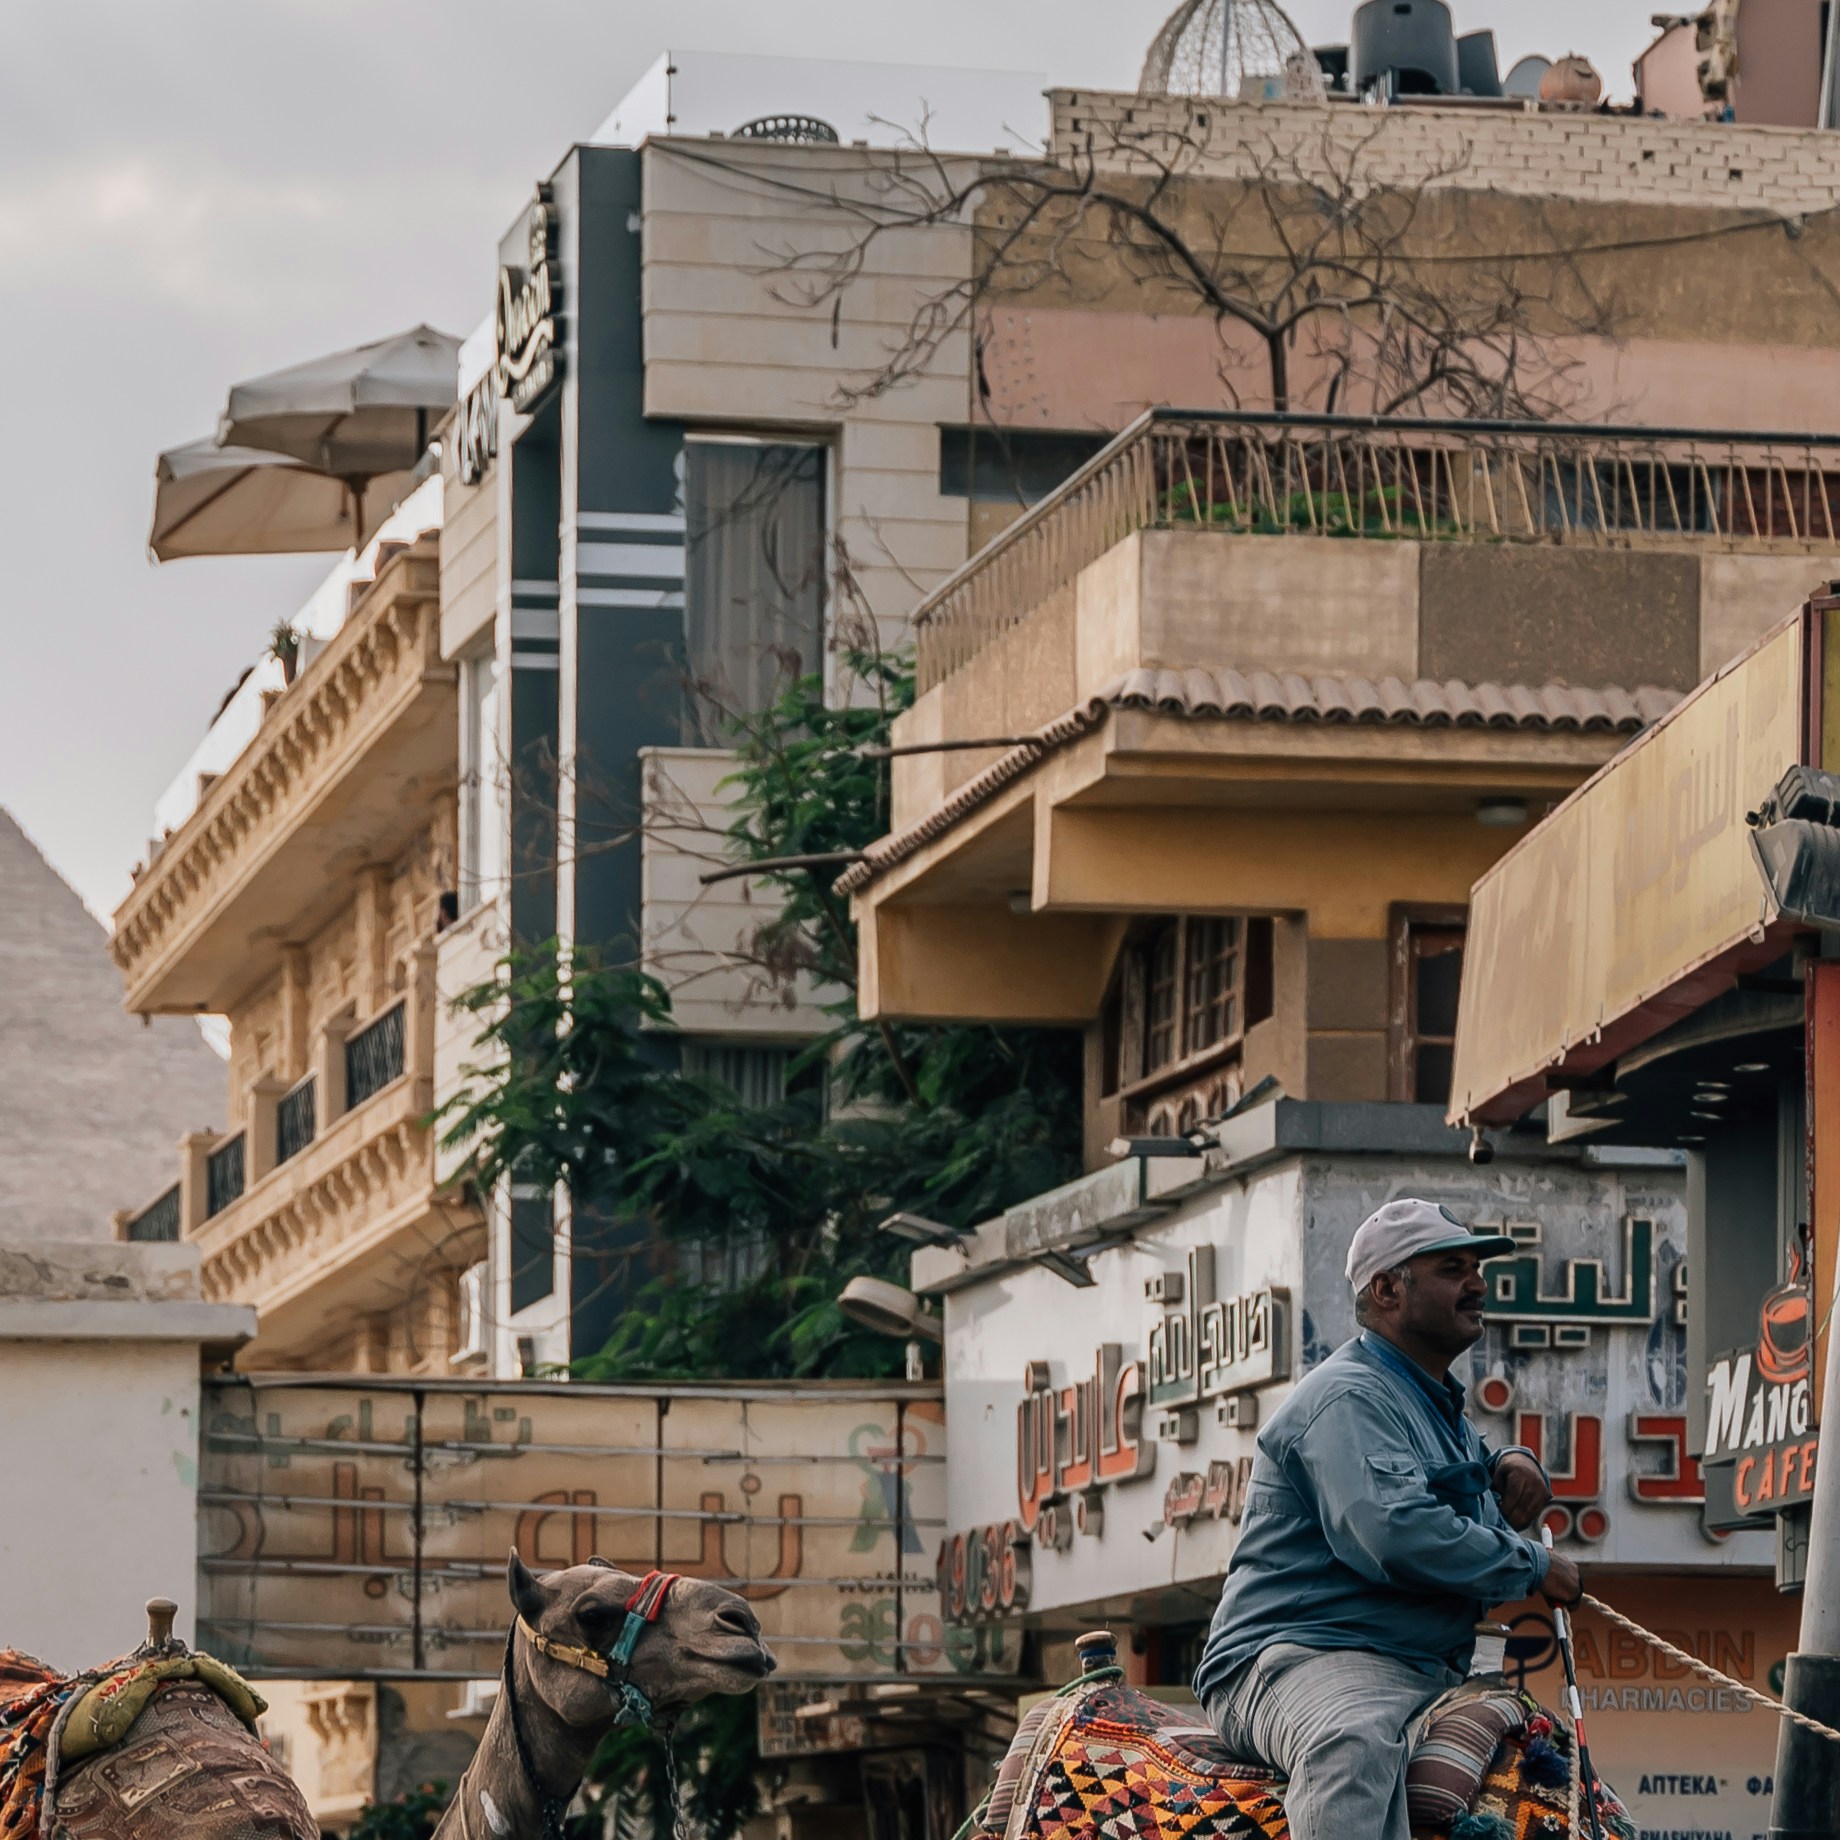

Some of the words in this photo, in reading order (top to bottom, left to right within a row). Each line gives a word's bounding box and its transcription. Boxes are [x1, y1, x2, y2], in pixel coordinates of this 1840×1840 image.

[1145, 1245, 1290, 1442] صيدلية
[1017, 1343, 1152, 1550] عابدين
[1705, 1353, 1809, 1457] MANG
[1735, 1439, 1819, 1508] CAFE
[935, 1520, 1017, 1619] 19036
[1561, 1629, 1755, 1681] ABDIN
[1561, 1684, 1753, 1713] PHARMACIES
[1638, 1774, 1718, 1795] АПТЕКА
